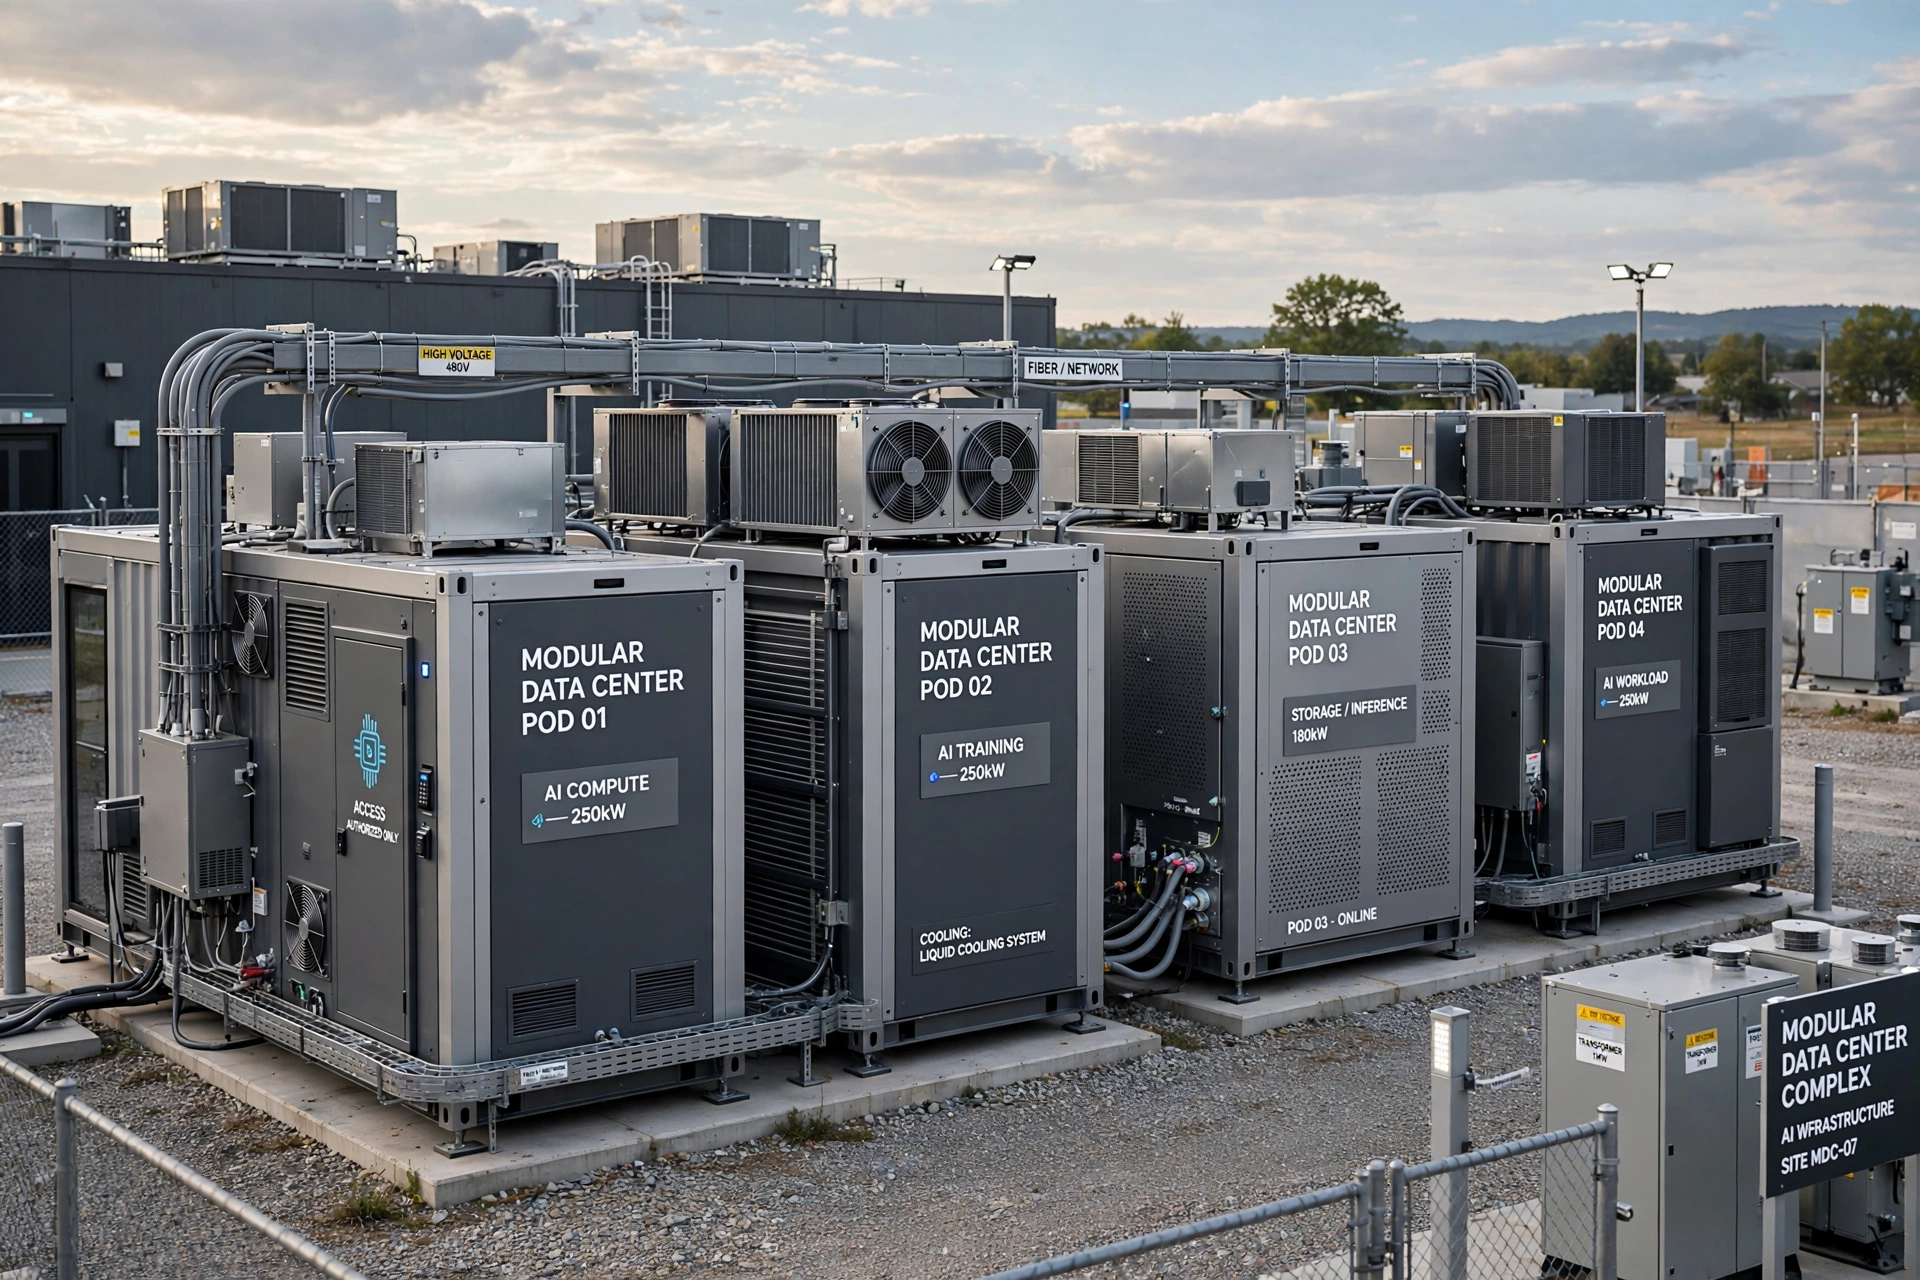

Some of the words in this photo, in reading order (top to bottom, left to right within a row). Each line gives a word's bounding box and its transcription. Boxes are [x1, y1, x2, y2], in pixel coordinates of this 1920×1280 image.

[423, 349, 447, 359] HIGH
[449, 349, 492, 361] VOLTAGE
[446, 361, 470, 373] 480V
[1028, 362, 1058, 375] FIBER
[1060, 362, 1065, 375] /
[1067, 362, 1119, 376] NETWORK
[1598, 573, 1662, 594] MODULAR
[1289, 590, 1370, 613] MODULAR
[1598, 599, 1632, 617] DATA
[1633, 595, 1683, 615] CENTER
[920, 616, 1020, 642] MODULAR
[1289, 618, 1331, 640] DATA
[1334, 613, 1397, 636] CENTER
[1597, 622, 1626, 641] POD
[1628, 620, 1645, 638] 04
[521, 641, 644, 671] MODULAR
[920, 647, 972, 672] DATA
[976, 641, 1053, 667] CENTER
[1289, 644, 1325, 666] POD
[1328, 642, 1349, 663] 03
[521, 676, 586, 704] DATA
[591, 668, 685, 698] CENTER
[920, 677, 964, 701] POD
[968, 674, 993, 697] 02
[1603, 676, 1614, 690] AI
[1616, 670, 1669, 689] WORKLOAD
[1291, 703, 1342, 722] STORAGE
[1344, 702, 1350, 717] /
[1351, 696, 1408, 716] INFERENCE
[1619, 692, 1649, 707] 250kW
[522, 709, 575, 736] POD
[581, 706, 607, 731] 01
[1292, 726, 1328, 743] 180kW
[938, 744, 953, 761] AI
[956, 736, 1025, 759] TRAINING
[959, 762, 1006, 782] 250kW
[544, 784, 562, 802] AI
[566, 774, 650, 800] COMPUTE
[353, 800, 386, 822] ACCESS
[571, 803, 627, 825] 250kW
[1287, 918, 1313, 936] POD
[1314, 915, 1329, 931] 03
[1337, 906, 1378, 927] ONLINE
[919, 926, 972, 946] COOLING:
[919, 945, 956, 963] LIQUID
[957, 936, 1006, 957] COOLING
[1006, 929, 1047, 948] SYSTEM
[1782, 1001, 1877, 1045] MODULAR
[1782, 1043, 1832, 1077] DATA
[1835, 1024, 1909, 1063] CENTER
[1781, 1063, 1872, 1109] COMPLEX
[1780, 1125, 1794, 1145] AI
[1781, 1151, 1809, 1175] SITE
[1810, 1137, 1858, 1167] MDC-07
